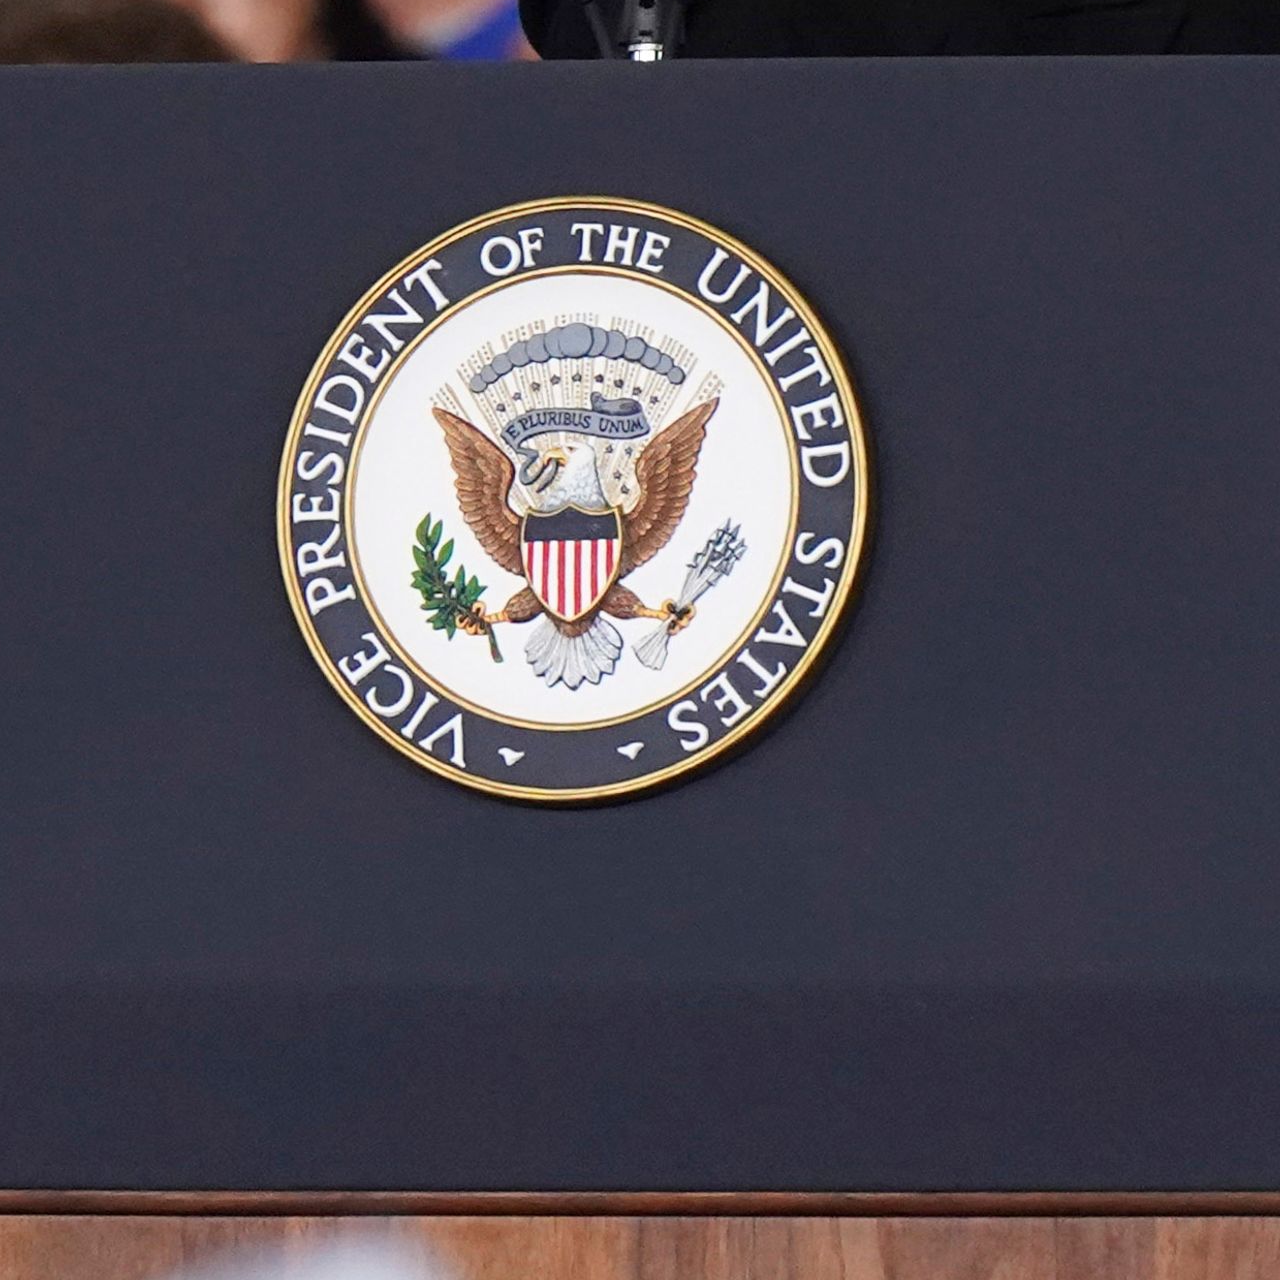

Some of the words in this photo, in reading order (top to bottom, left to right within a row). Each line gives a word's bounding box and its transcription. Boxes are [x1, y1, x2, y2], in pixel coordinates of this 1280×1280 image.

[479, 226, 546, 276] OF
[570, 222, 672, 273] THE
[291, 259, 451, 616] PRESIDENT
[505, 424, 520, 440] E
[519, 411, 592, 430] PLURIBUS
[598, 417, 644, 433] UNUM
[696, 247, 853, 488] UNITED
[337, 629, 468, 770] VICE
[666, 530, 846, 752] STATES
